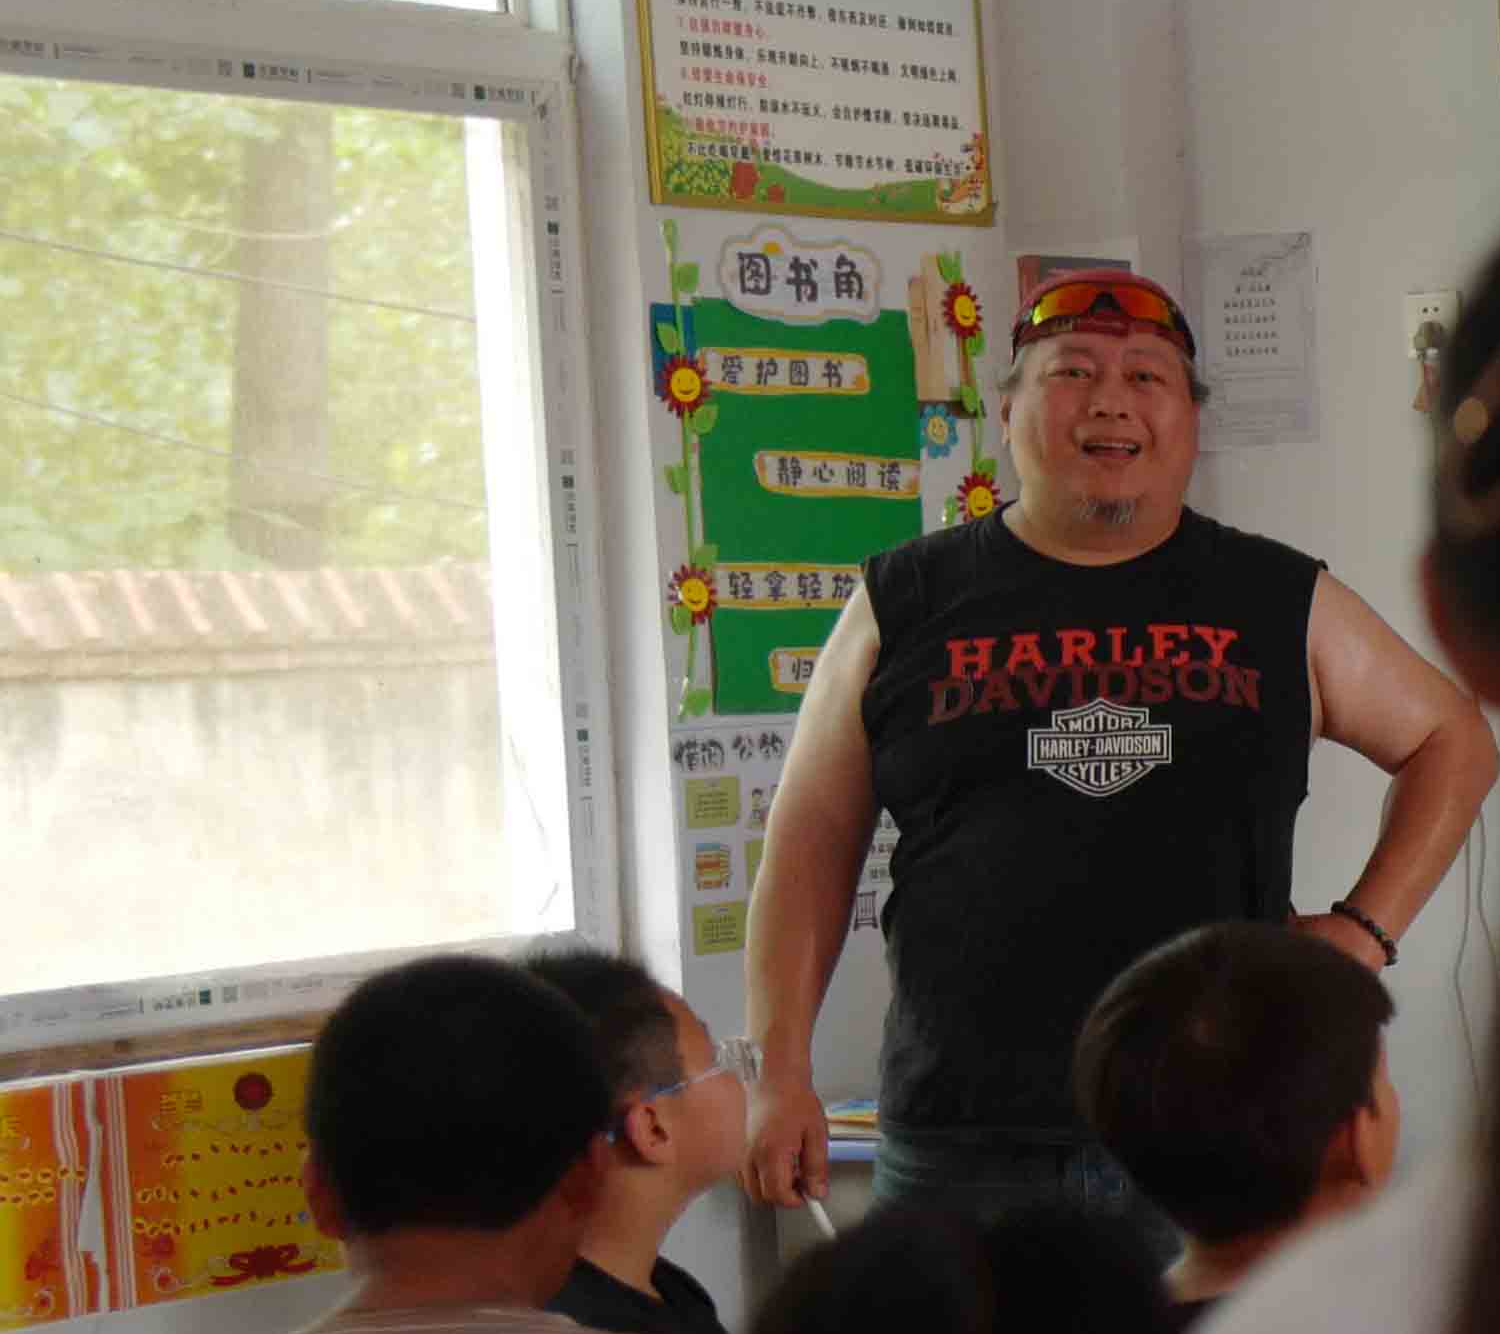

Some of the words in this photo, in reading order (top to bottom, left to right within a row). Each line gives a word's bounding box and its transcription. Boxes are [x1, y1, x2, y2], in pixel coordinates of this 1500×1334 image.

[737, 252, 863, 302] 图书角
[721, 355, 843, 387] 爱护图书
[778, 456, 901, 491] 静心阅读
[728, 570, 855, 601] 轻拿轻放
[945, 623, 1239, 681] HARLEY
[928, 661, 1261, 726] DAVIDSON
[1068, 712, 1135, 733] MOTOR
[1039, 735, 1162, 758] HARLEY-DAVIDSON
[1070, 762, 1134, 787] CYCLES
